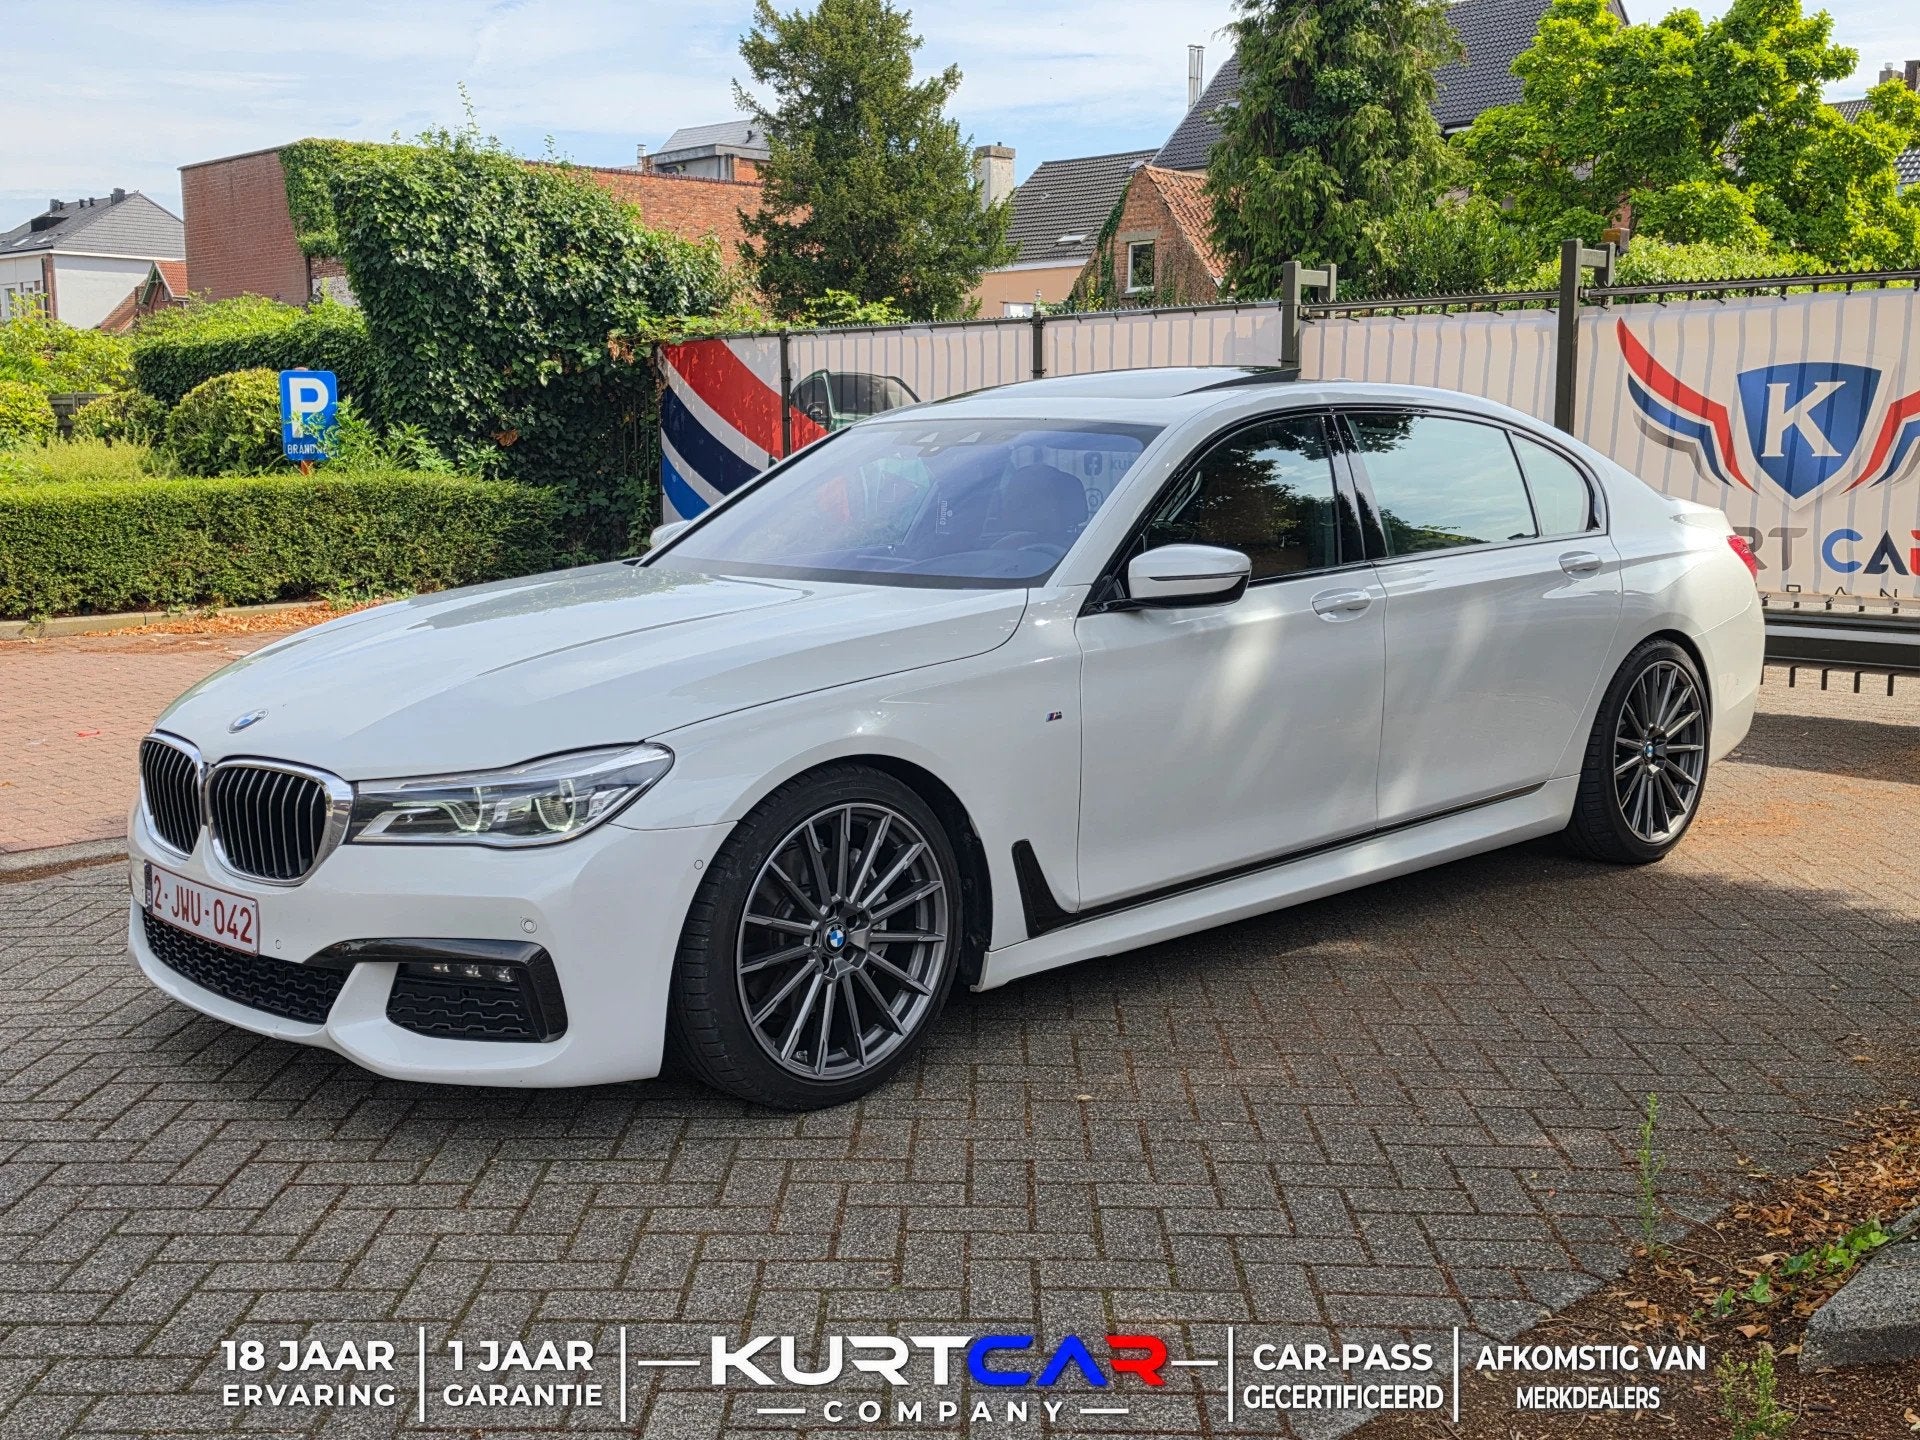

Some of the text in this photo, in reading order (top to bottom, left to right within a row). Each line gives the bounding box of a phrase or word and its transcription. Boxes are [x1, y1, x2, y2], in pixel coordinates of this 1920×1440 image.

[289, 377, 329, 438] P
[1761, 381, 1846, 457] K
[154, 874, 252, 944] 2-JWU-042
